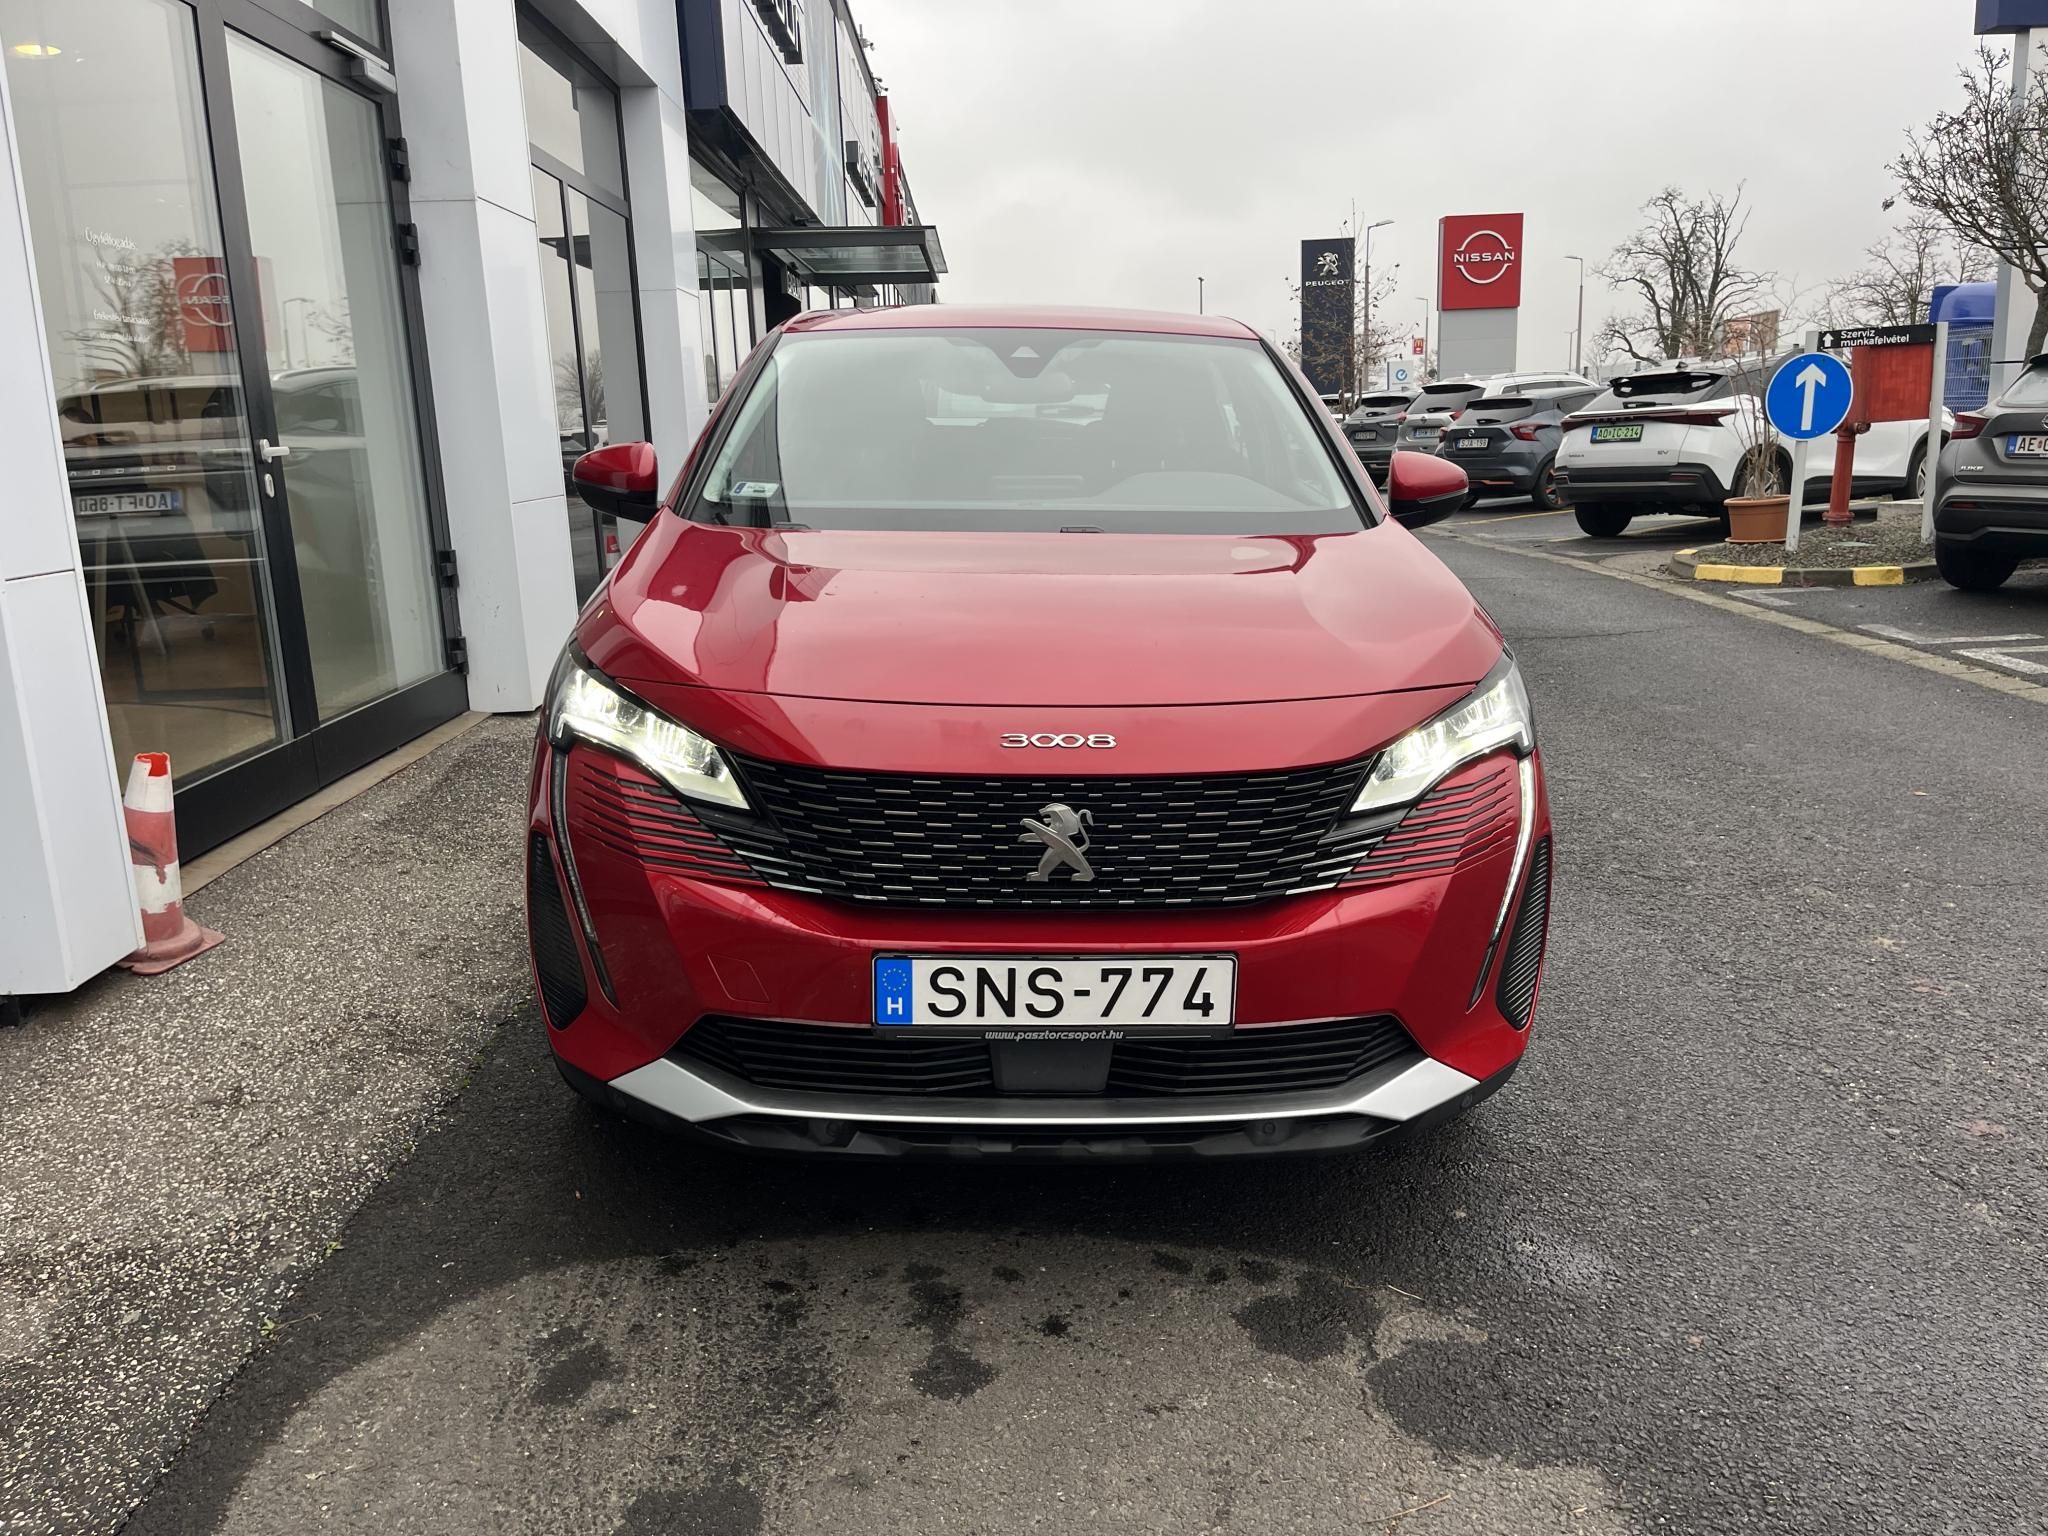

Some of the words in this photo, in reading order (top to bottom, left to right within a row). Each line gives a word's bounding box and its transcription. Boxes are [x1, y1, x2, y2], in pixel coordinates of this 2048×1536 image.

[1453, 251, 1515, 263] NISSAN
[1305, 279, 1351, 287] PEUGEOT
[1840, 330, 1875, 339] Szerviz
[1840, 334, 1910, 347] munkafelvétel
[2017, 437, 2038, 452] AE
[1000, 733, 1117, 748] 3008
[927, 966, 1215, 1018] SNS-774
[887, 996, 903, 1016] H
[984, 1030, 1124, 1042] www.pasztorcsoport.hu
